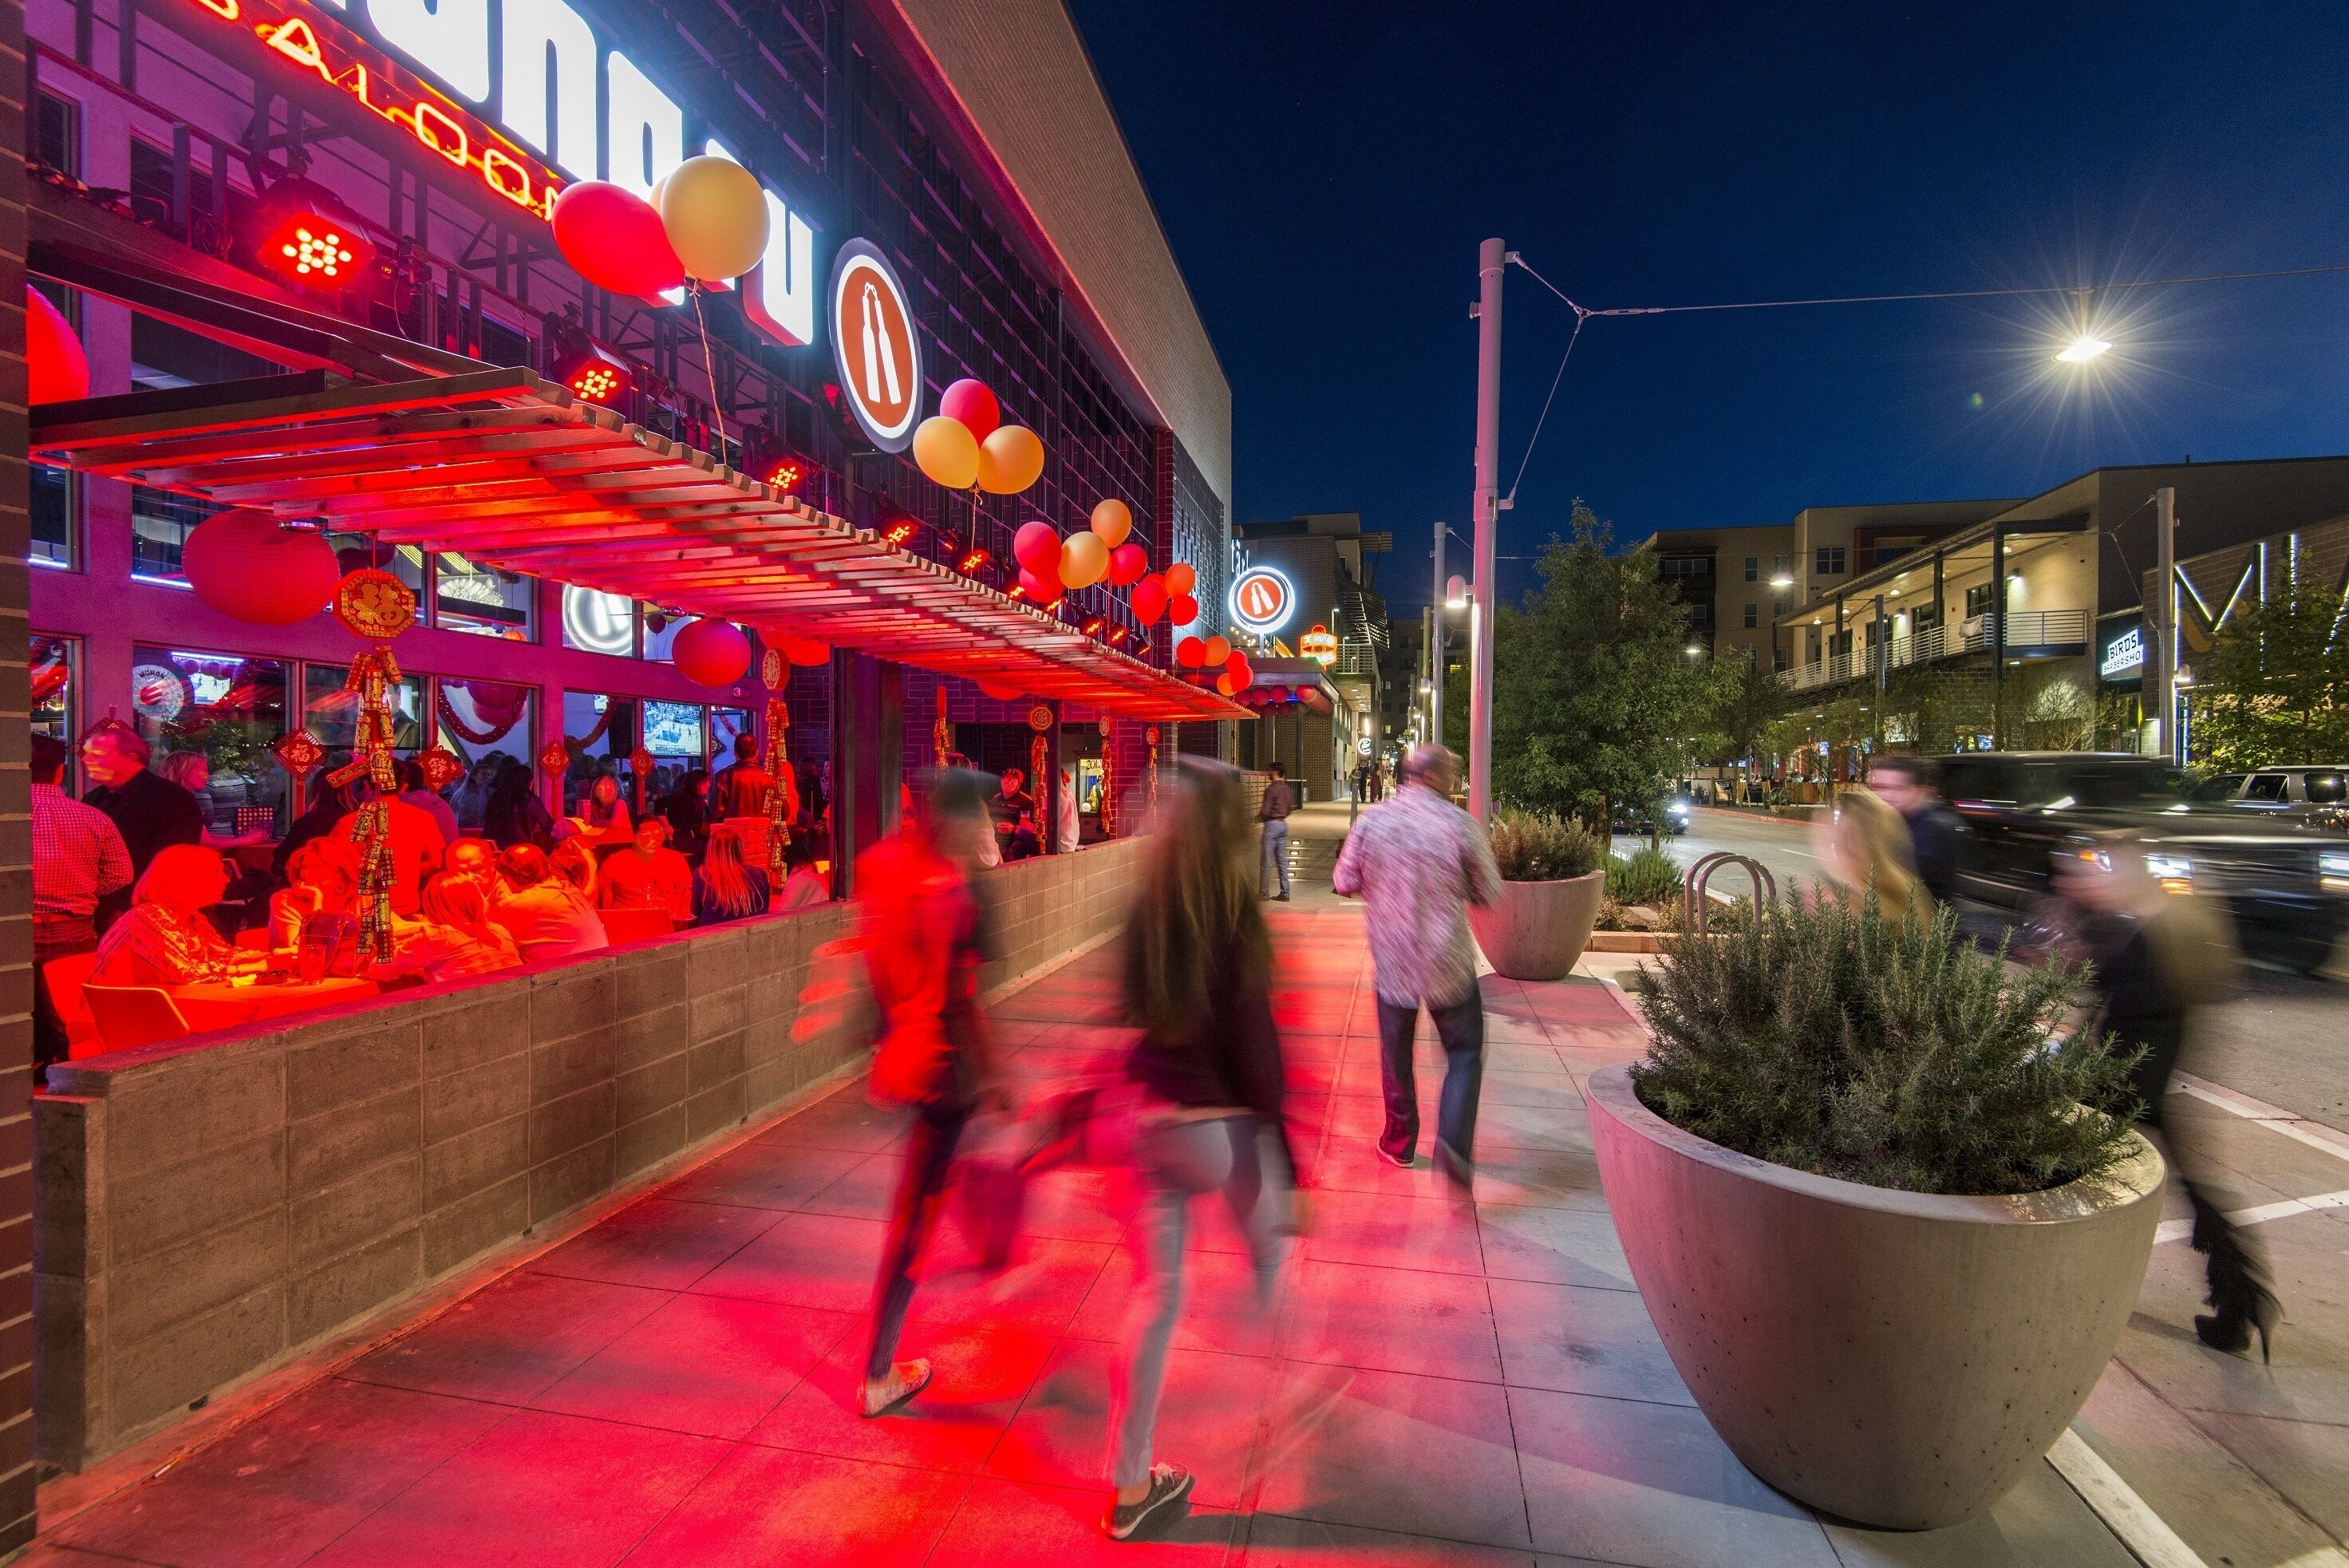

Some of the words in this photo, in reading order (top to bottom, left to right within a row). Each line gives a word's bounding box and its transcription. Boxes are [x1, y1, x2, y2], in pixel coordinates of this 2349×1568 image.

[2109, 634, 2137, 659] BIRDS
[138, 669, 166, 680] WUHAN
[1086, 760, 1103, 770] ZOL
